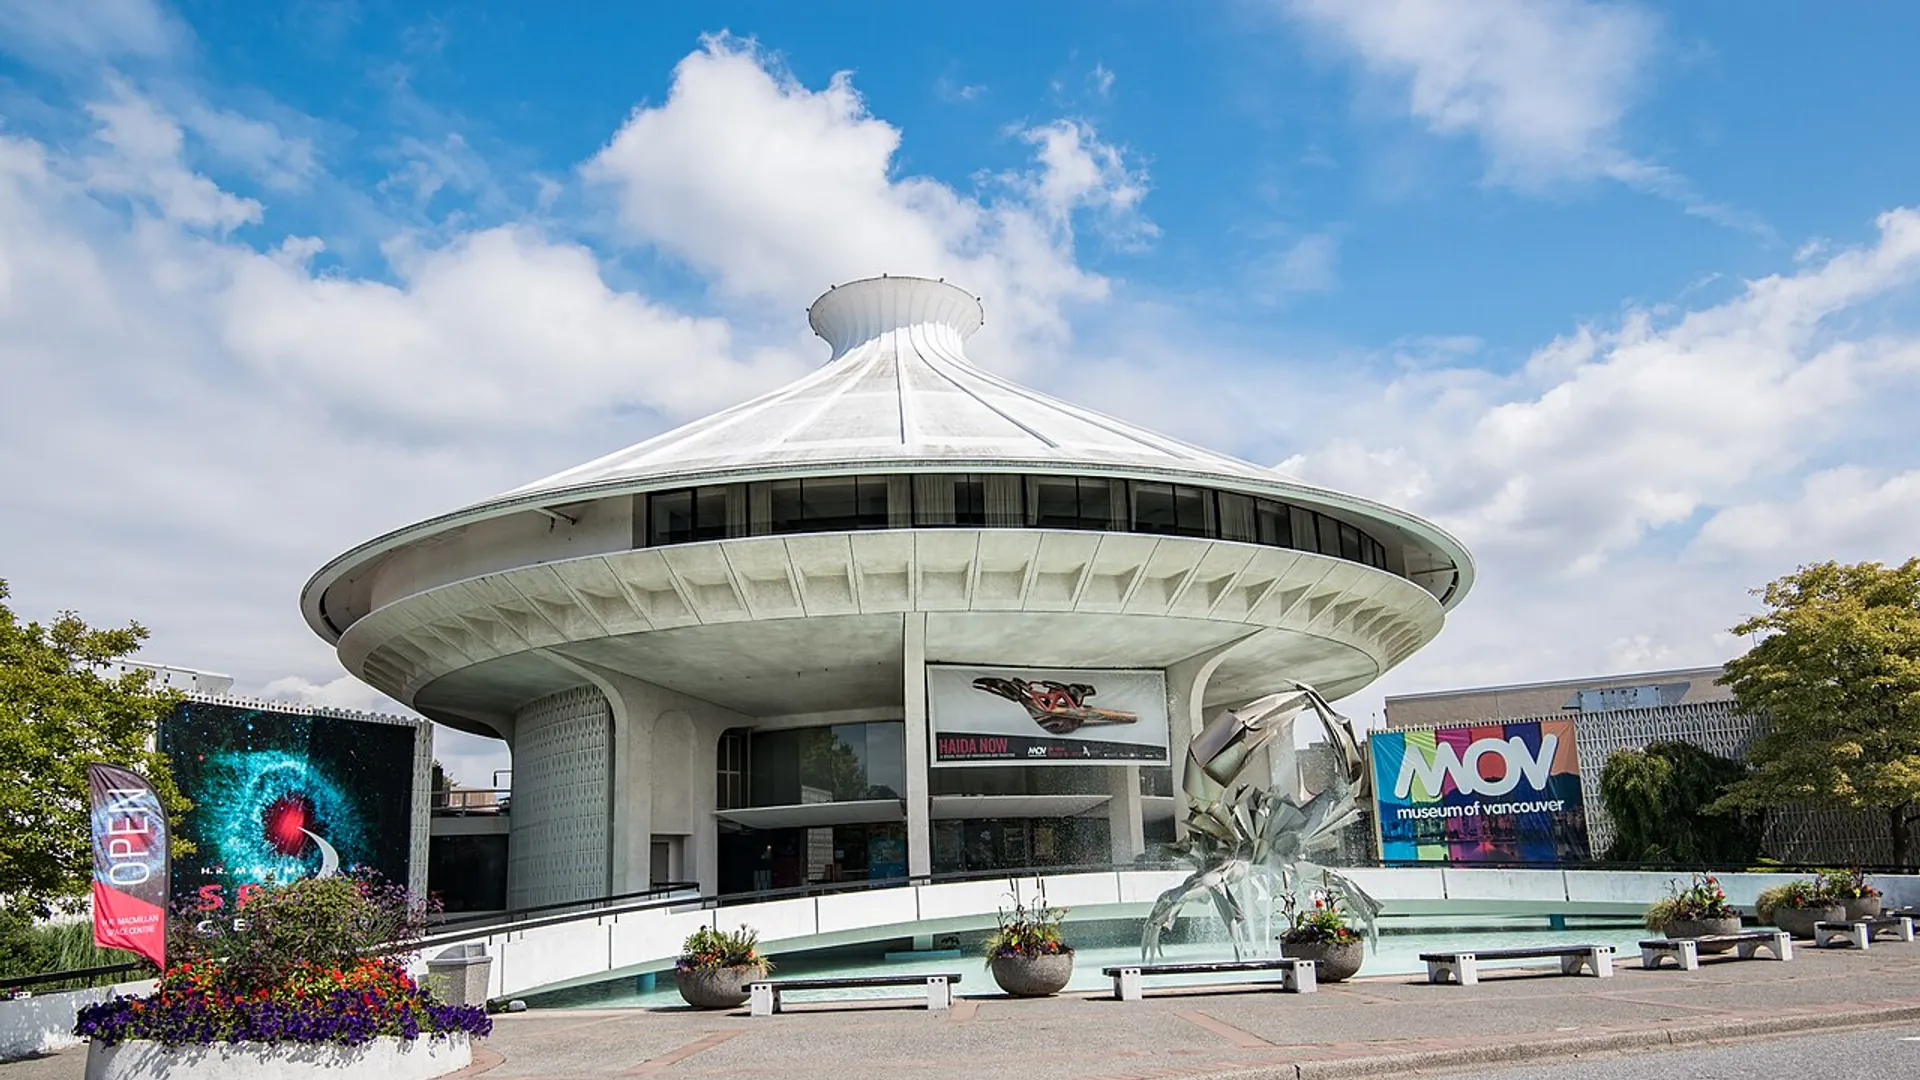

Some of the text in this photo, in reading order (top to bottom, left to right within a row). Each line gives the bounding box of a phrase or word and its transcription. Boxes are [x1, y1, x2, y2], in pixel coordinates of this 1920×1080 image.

[938, 738, 1008, 754] HAIDA NOW
[1394, 733, 1558, 798] MOV
[1397, 799, 1565, 820] museum of vancouver
[107, 788, 150, 885] OPEN
